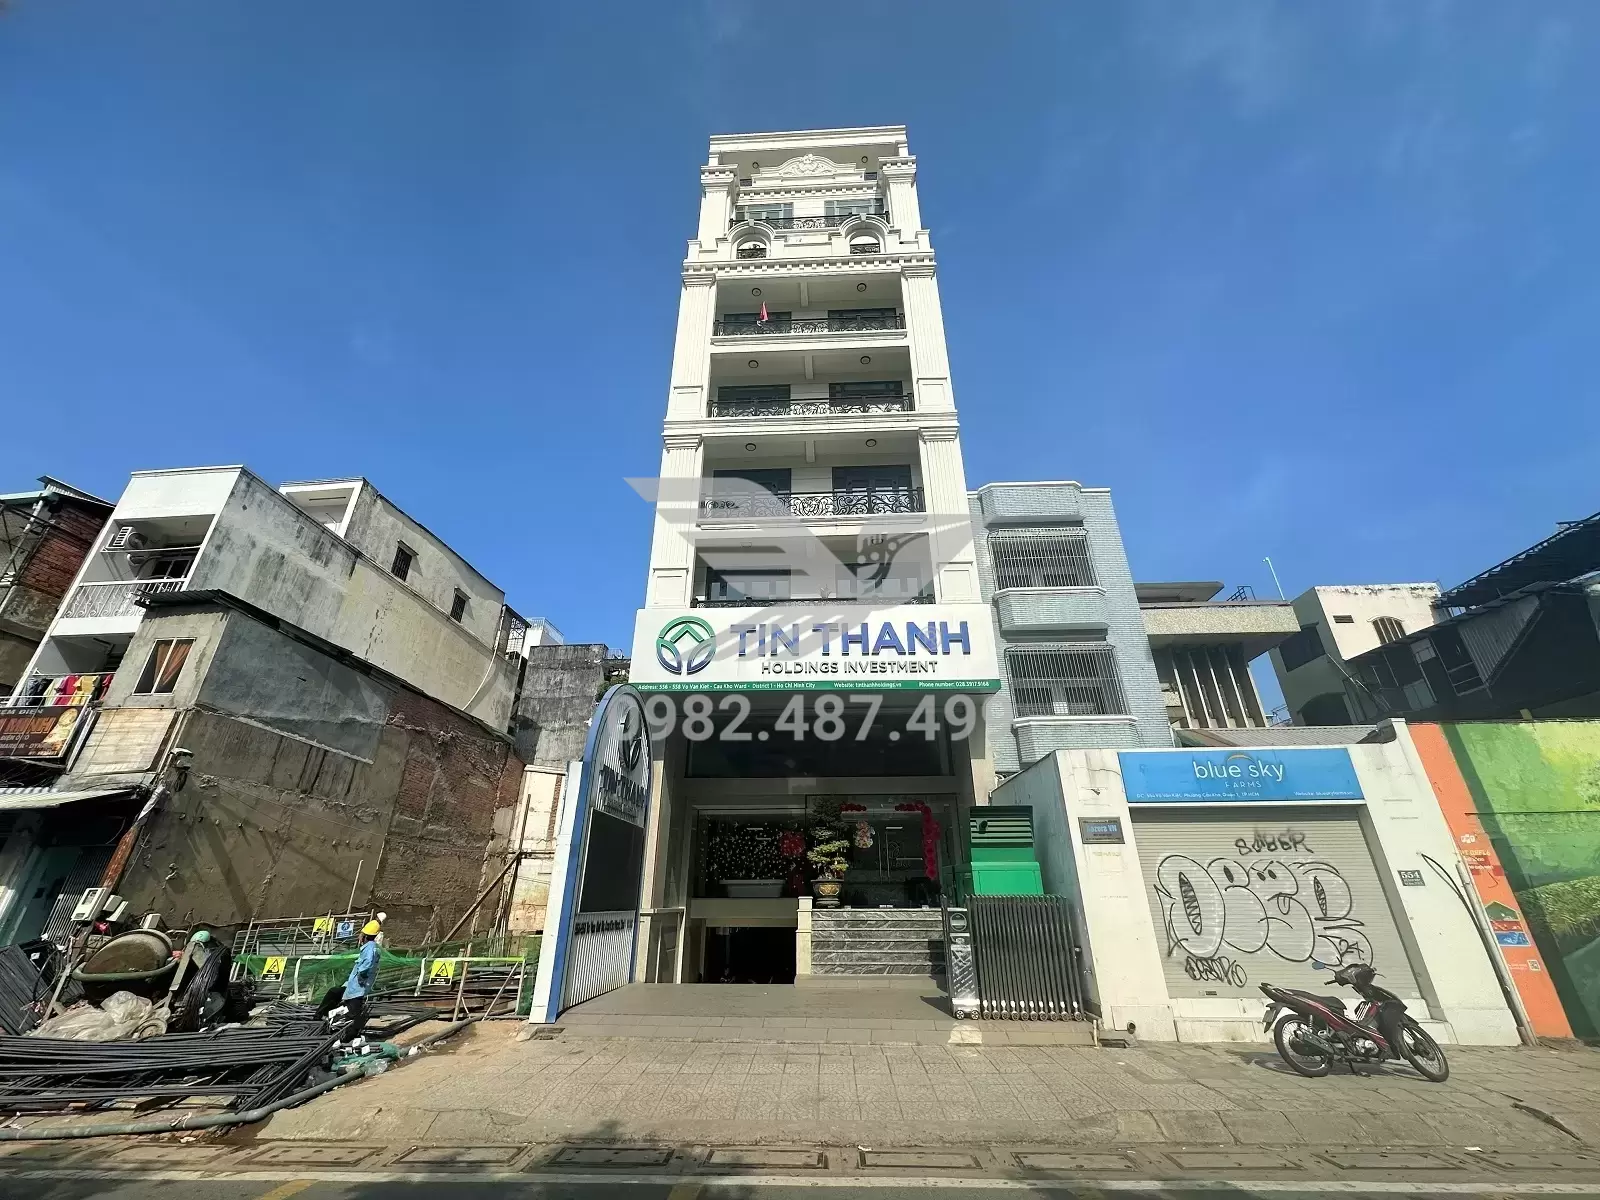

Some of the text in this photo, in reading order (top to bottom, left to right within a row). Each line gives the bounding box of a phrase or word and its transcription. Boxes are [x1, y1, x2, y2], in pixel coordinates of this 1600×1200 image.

[730, 621, 971, 657] TIN THANH
[761, 660, 938, 675] HOLDINGS INVESTMENT
[1192, 759, 1284, 782] blue sky
[1225, 780, 1262, 788] FARMS
